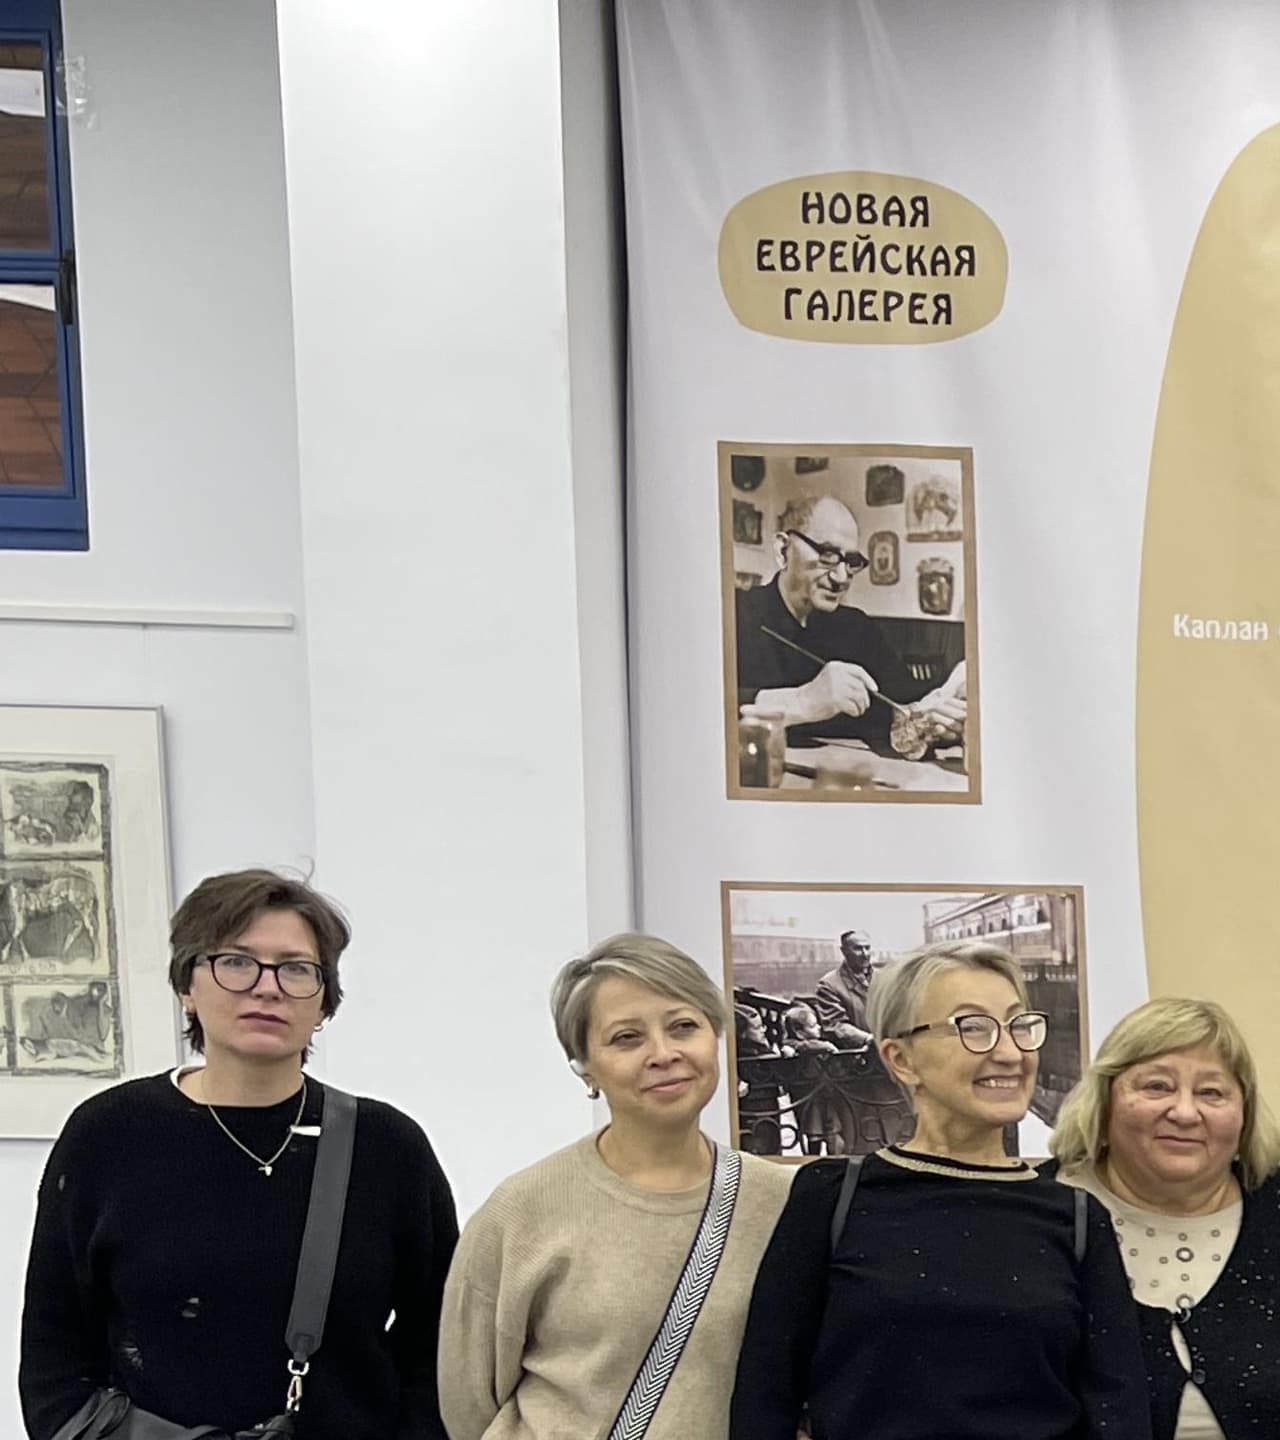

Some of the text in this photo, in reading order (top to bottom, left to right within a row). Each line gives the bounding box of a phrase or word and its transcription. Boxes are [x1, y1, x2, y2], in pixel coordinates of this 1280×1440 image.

[801, 191, 931, 229] НОВАЯ
[756, 234, 977, 278] ЕВРЕЙСКАЯ
[783, 287, 954, 326] ГАЛЕРЕЯ
[1172, 613, 1269, 641] Каплан
